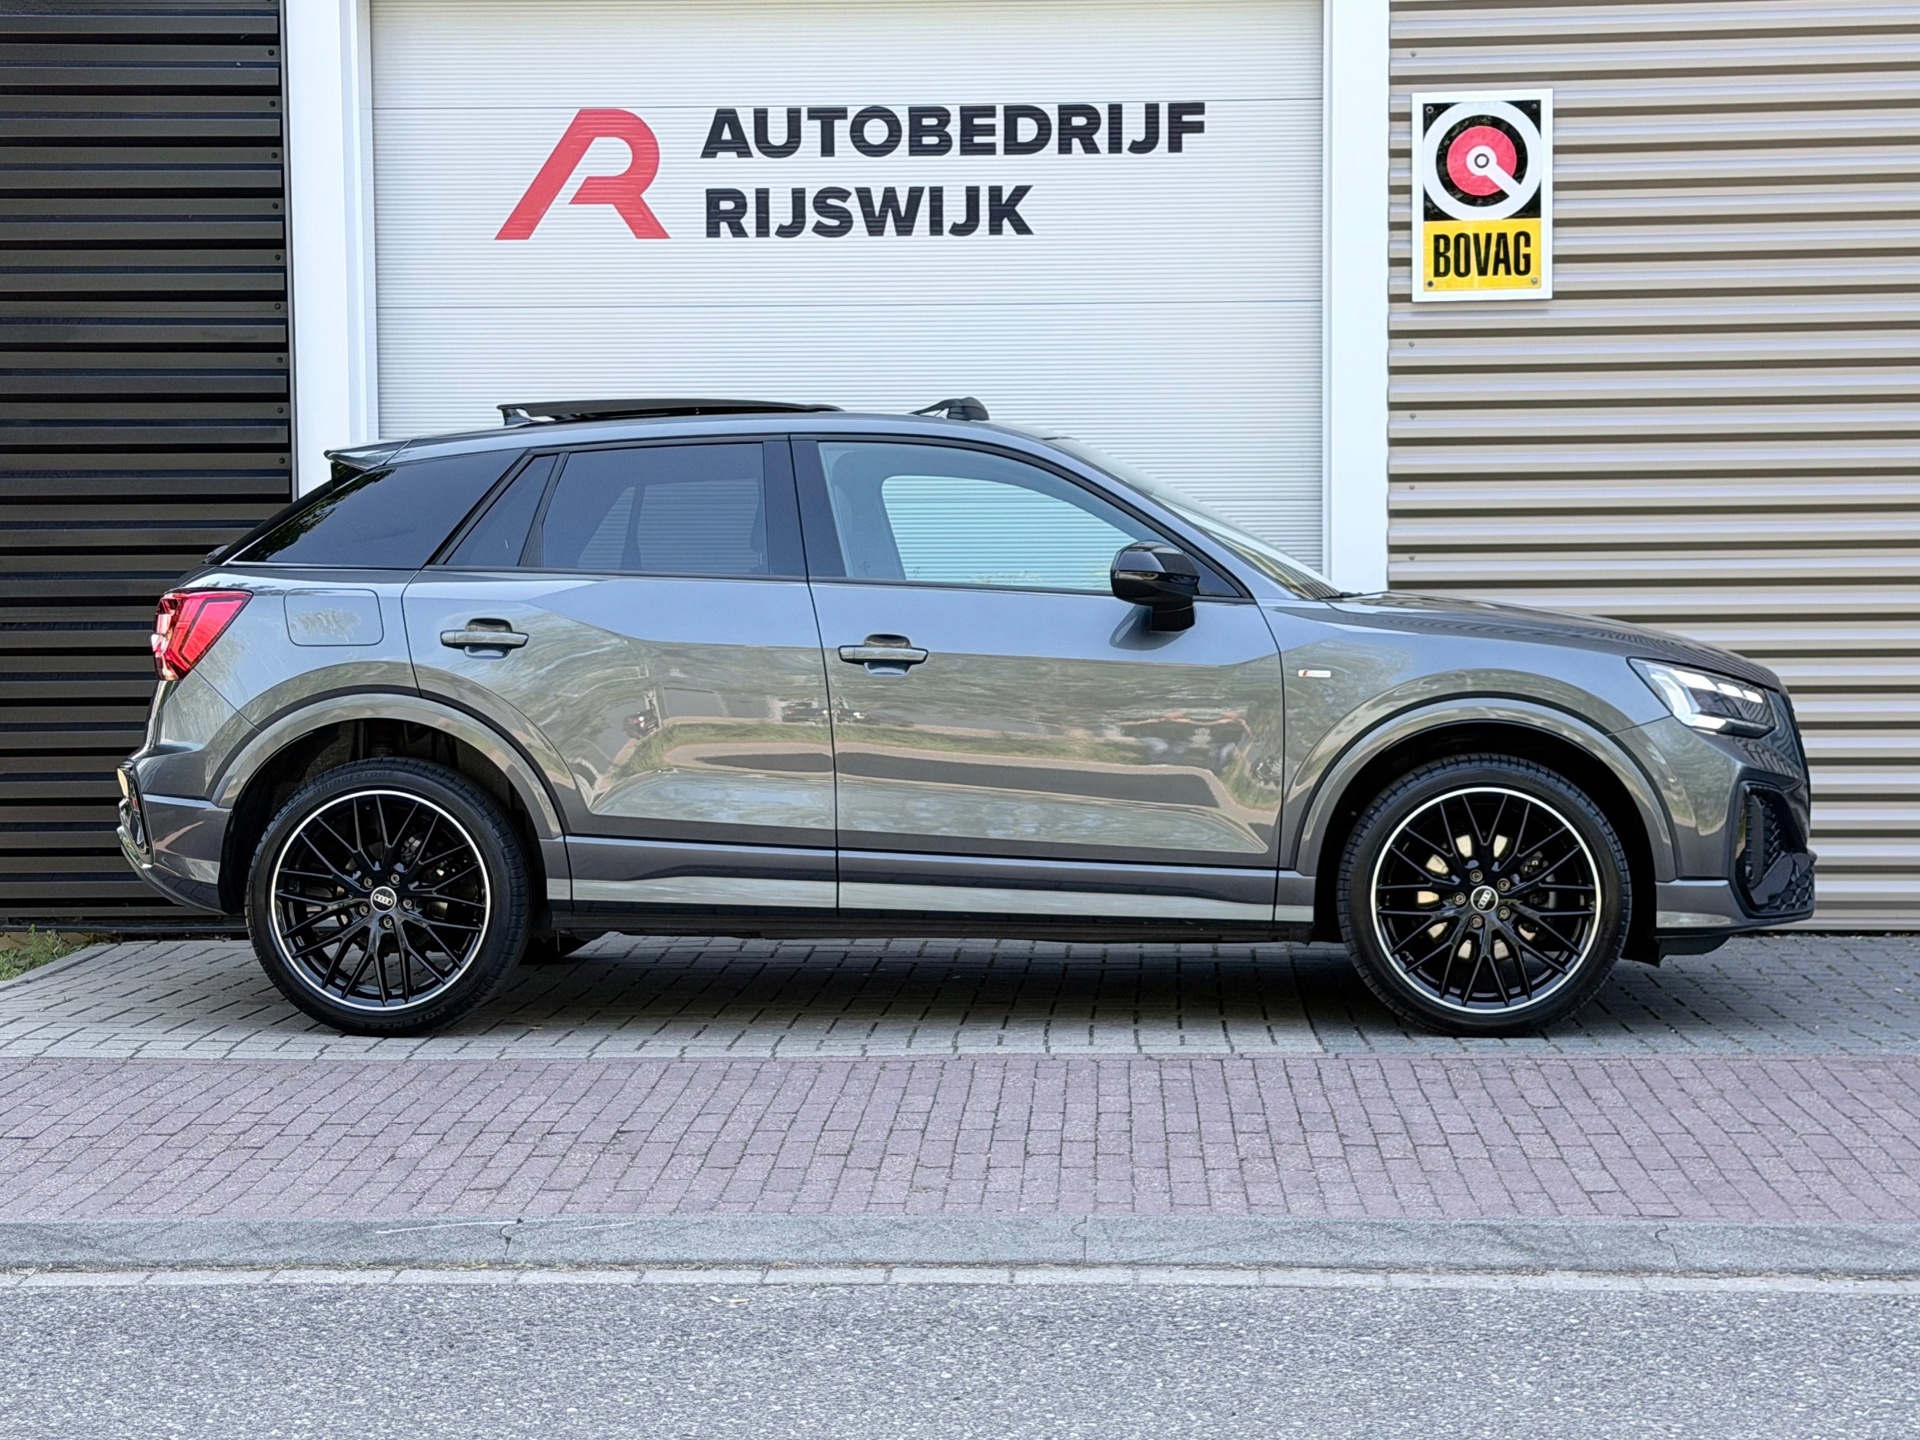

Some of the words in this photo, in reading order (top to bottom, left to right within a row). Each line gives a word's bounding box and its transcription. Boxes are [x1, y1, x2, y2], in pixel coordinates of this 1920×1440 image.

[700, 102, 1206, 159] AUTOBEDRIJF
[705, 185, 1034, 239] RIJSWIJK
[1433, 230, 1532, 278] BOVAG
